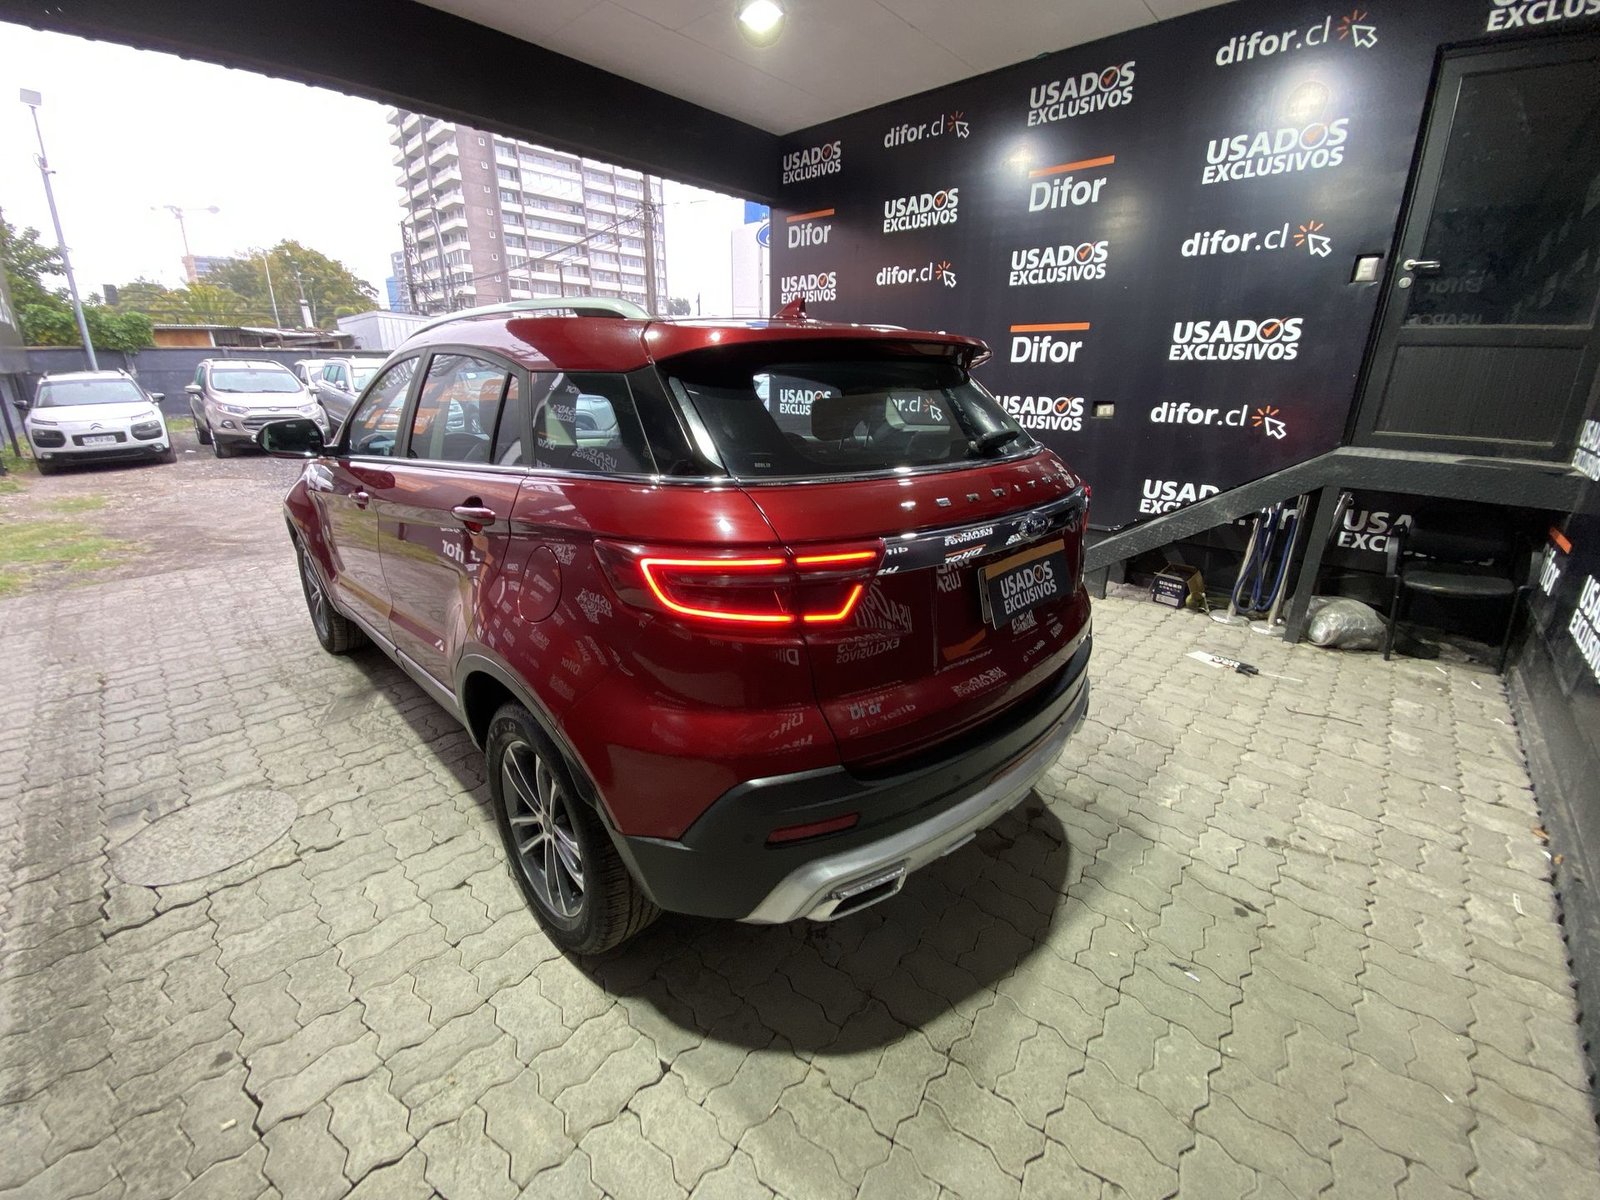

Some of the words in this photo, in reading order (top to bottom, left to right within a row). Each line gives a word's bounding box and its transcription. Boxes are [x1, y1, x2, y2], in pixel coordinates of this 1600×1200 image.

[1486, 0, 1600, 32] EXCLUS
[1215, 15, 1332, 67] difor.cl
[1030, 61, 1136, 109] USADOS
[1027, 86, 1134, 127] EXCLUSIVOS
[884, 114, 945, 148] difor.cl
[1206, 118, 1349, 164] USADOS
[782, 140, 842, 172] USADOS
[782, 158, 842, 185] EXCLUSIVOS
[1201, 146, 1345, 185] EXCLUSIVOS
[884, 187, 959, 218] USADOS
[1028, 176, 1107, 213] Difor
[787, 222, 832, 249] Difor
[883, 209, 958, 234] EXCLUSIVOS
[1181, 222, 1290, 257] difor.cl
[1011, 240, 1109, 271] USADOS
[781, 271, 837, 293] USADOS
[876, 262, 934, 287] difor.cl
[1009, 262, 1107, 286] EXCLUSIVOS
[1172, 317, 1304, 344] USADOS
[1010, 336, 1083, 363] Difor
[1168, 342, 1299, 361] EXCLUSIVOS
[779, 404, 812, 416] EXCLUS
[1150, 402, 1249, 427] difor.cl
[1142, 478, 1220, 503] USAD
[1343, 508, 1413, 535] USA
[1000, 560, 1054, 599] USADOS
[1003, 578, 1058, 615] EXCLUSIVOS
